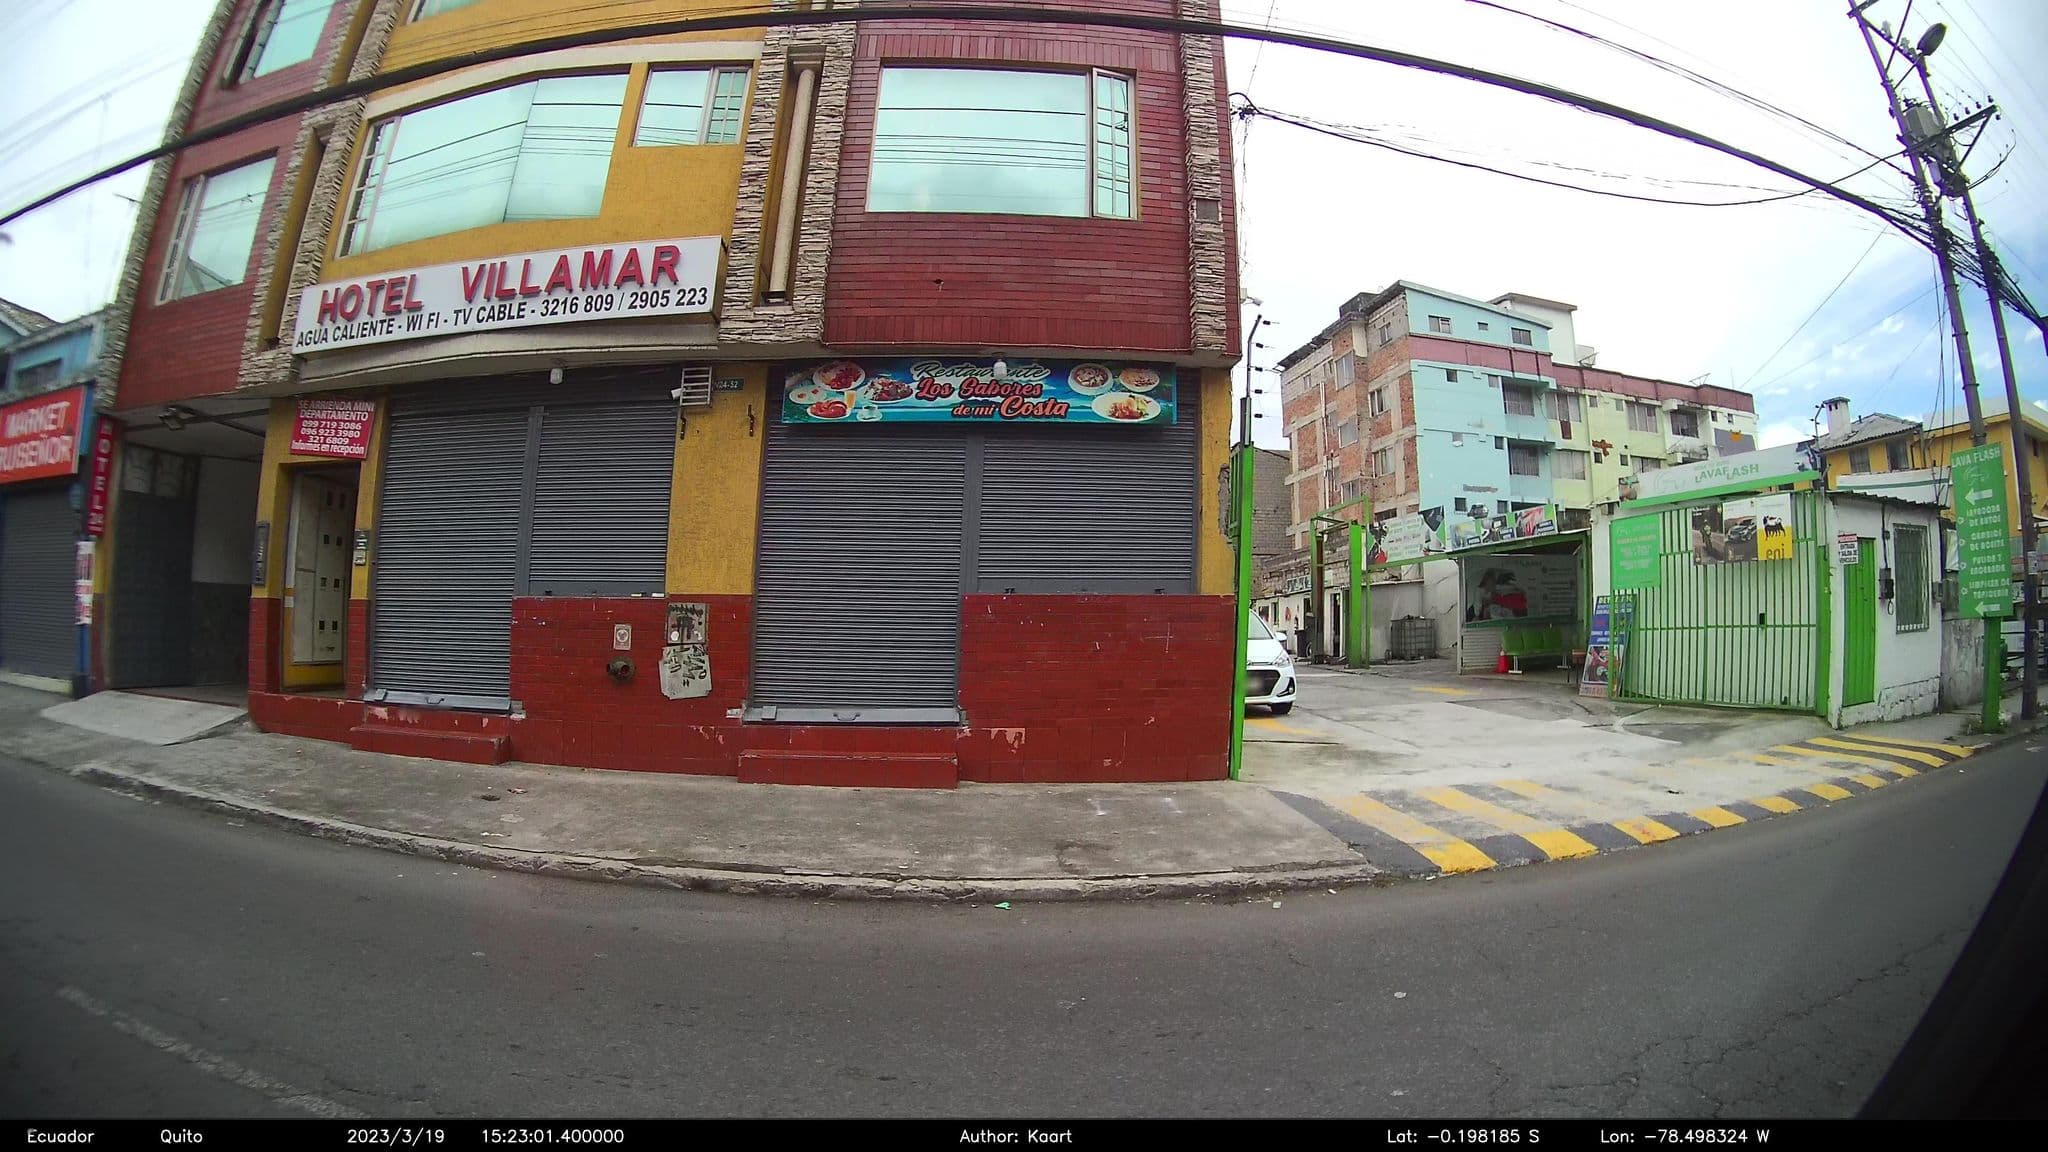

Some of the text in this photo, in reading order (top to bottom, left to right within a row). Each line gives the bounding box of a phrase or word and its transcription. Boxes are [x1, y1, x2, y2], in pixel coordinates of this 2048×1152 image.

[317, 245, 681, 325] HOTEL VILLAMAR
[296, 328, 328, 348] AGUA
[332, 318, 395, 341] CALIENTE
[406, 314, 423, 332] WI
[426, 312, 440, 329] FI
[453, 307, 473, 327] TV
[476, 302, 527, 324] CABLE
[540, 296, 579, 316] 3216
[584, 293, 614, 312] 809
[627, 289, 671, 310] 2905
[676, 287, 708, 307] 223
[913, 361, 1049, 378] Restaurnte
[917, 377, 1043, 399] Los Sabores
[298, 400, 375, 411] SE ARRIENDA MINI
[953, 396, 1069, 417] de mi Costa
[5, 401, 70, 439] MARKET
[300, 409, 368, 421] DEPARTAMENTO
[302, 420, 362, 430] 099 719 3086
[318, 429, 335, 437] 923
[336, 430, 360, 438] 3980
[326, 437, 349, 445] 6809
[291, 440, 364, 456] Informes en recepción
[1951, 447, 2001, 468] LAVA FLASH
[1969, 518, 1979, 527] DE
[1766, 544, 1785, 560] eni
[1969, 543, 1979, 551] DE
